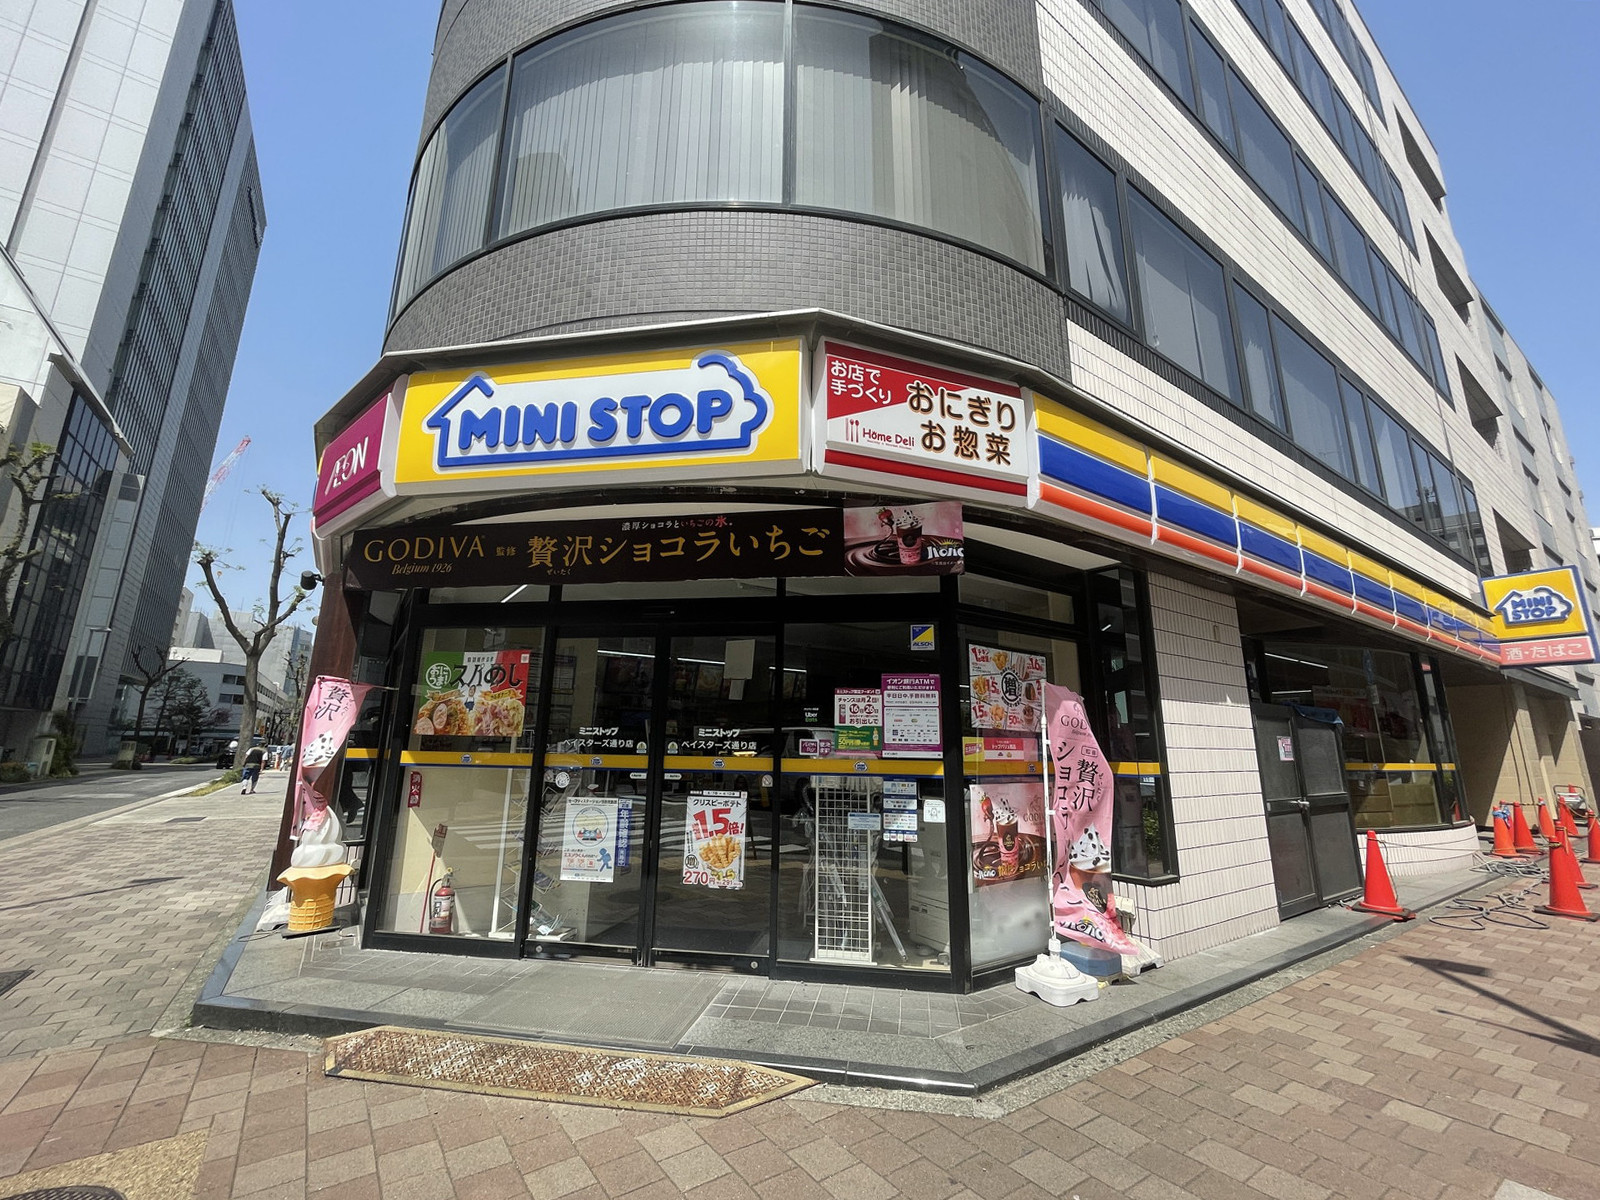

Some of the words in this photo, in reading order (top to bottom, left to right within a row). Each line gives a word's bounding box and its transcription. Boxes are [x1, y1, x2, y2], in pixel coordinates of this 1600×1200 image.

[829, 360, 881, 383] お店で
[830, 378, 892, 404] 手づくり
[905, 380, 1015, 432] おにぎり
[458, 401, 578, 450] MINI
[588, 389, 734, 442] STOP
[895, 433, 915, 447] Deli
[920, 419, 1012, 467] お惣菜
[364, 535, 486, 563] GODIVA
[527, 524, 831, 568] 贅沢ショコラいちご
[391, 563, 429, 576] Belgium
[431, 561, 453, 573] 1926
[1510, 595, 1553, 610] MINI
[1511, 606, 1558, 621] STOP
[1505, 643, 1584, 661] 酒・たばこ
[450, 663, 523, 688] スパめし
[578, 726, 620, 736] ミニストップ
[698, 728, 740, 738] ミニストップ
[681, 740, 757, 750] ベイスターズ通り店
[1072, 758, 1099, 812] 贅沢
[693, 799, 742, 808] クリスピーポテト
